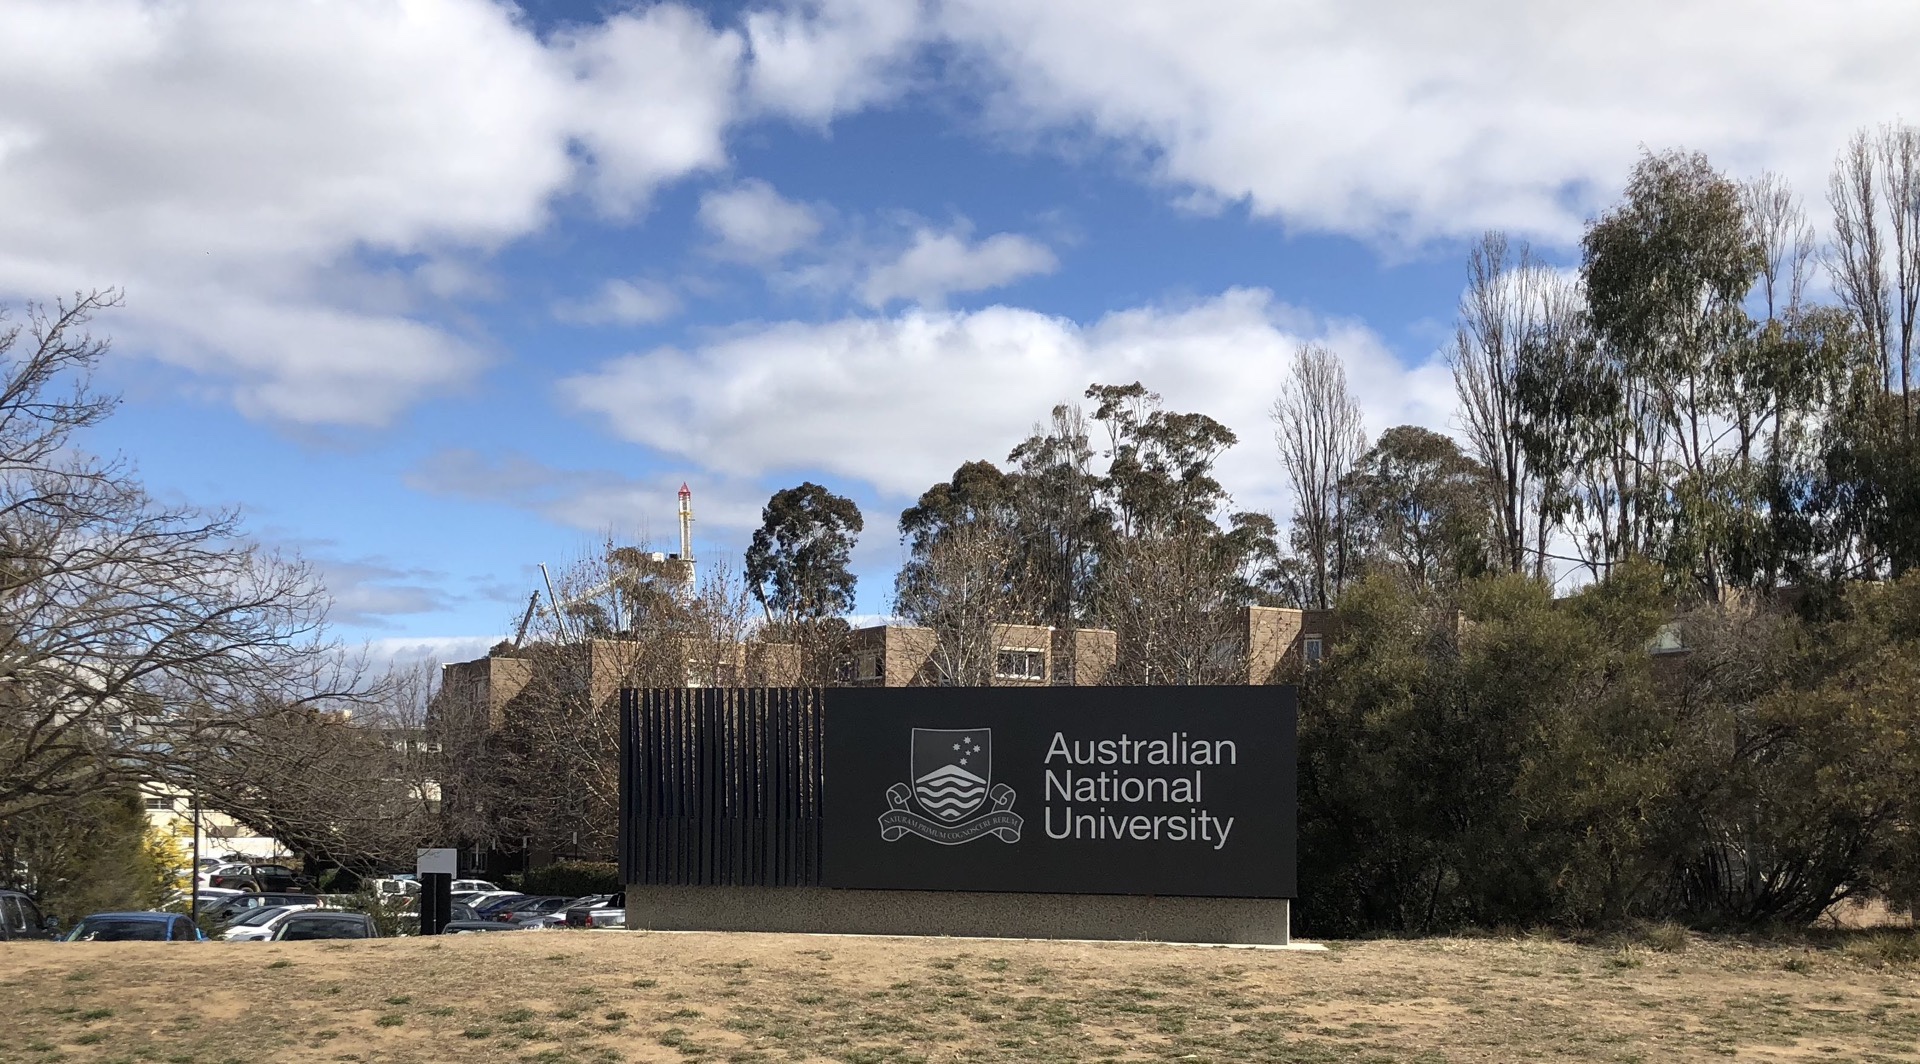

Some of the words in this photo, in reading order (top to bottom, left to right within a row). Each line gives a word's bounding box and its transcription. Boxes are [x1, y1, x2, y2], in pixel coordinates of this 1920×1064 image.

[1043, 731, 1238, 766] Australian
[1044, 769, 1202, 804] National
[884, 816, 918, 829] NATURAM
[918, 824, 947, 839] PRIMUM
[947, 820, 992, 840] COGNOSCERE
[992, 816, 1018, 827] RERUM
[1044, 806, 1236, 851] University
